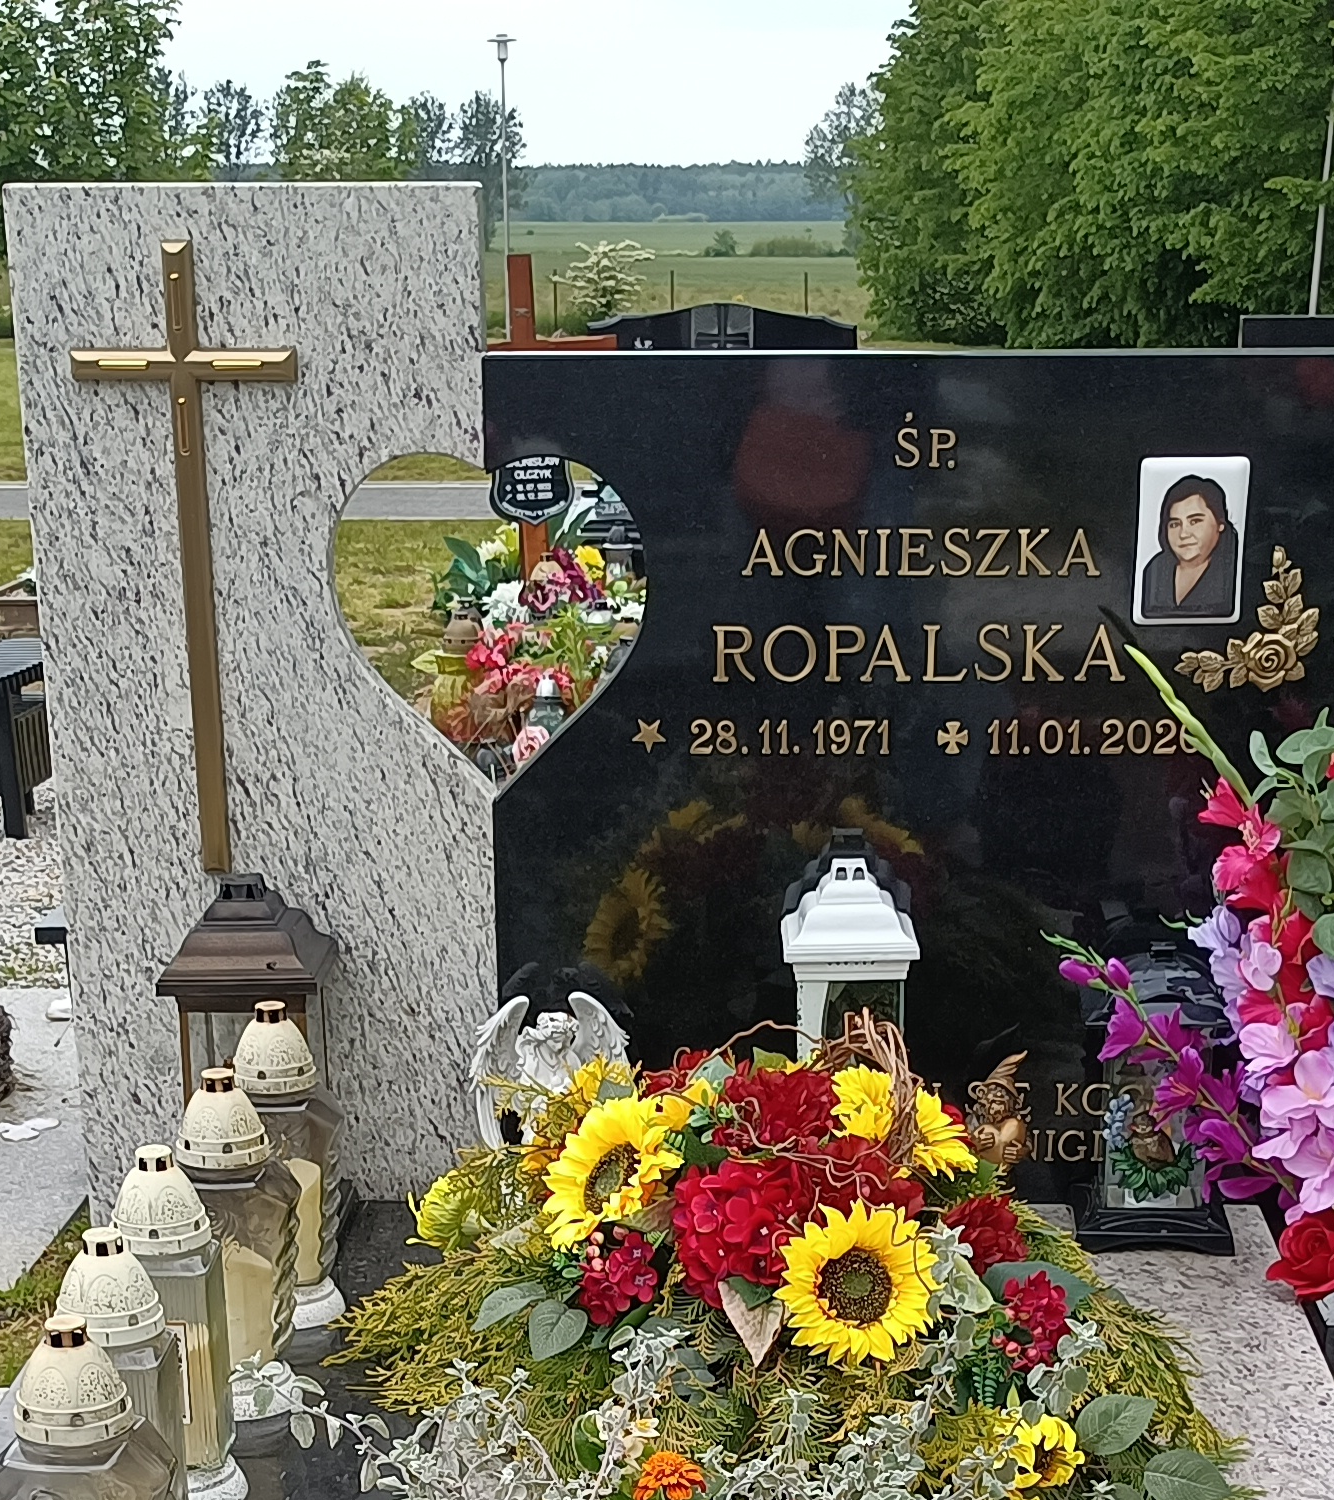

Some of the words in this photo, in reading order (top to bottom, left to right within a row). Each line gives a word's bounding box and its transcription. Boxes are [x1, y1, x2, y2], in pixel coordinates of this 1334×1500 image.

[514, 468, 553, 480] OLCZYK
[741, 527, 1101, 577] AGNIESZKA
[712, 624, 1126, 683] ROPALSKA
